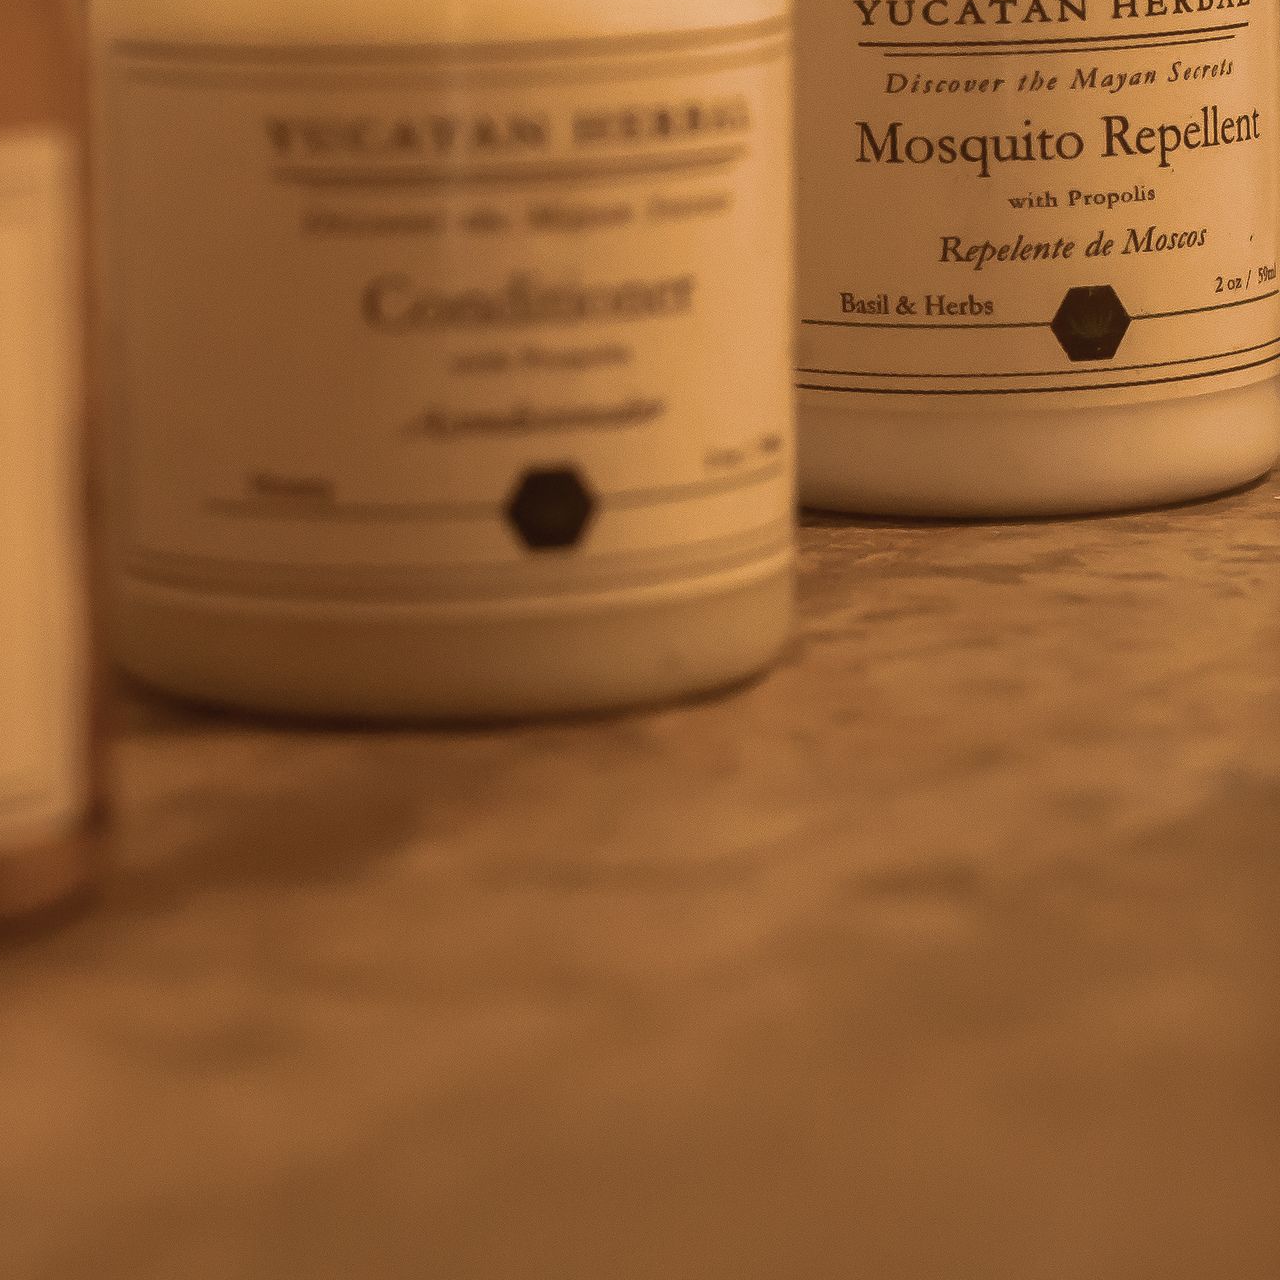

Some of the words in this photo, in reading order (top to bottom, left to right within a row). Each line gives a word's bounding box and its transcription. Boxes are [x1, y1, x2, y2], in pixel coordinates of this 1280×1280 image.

[883, 71, 1006, 96] Discover
[1017, 70, 1058, 93] the
[1069, 66, 1157, 95] Mayan
[1167, 57, 1235, 83] Secrets
[854, 119, 1085, 178] Mosquito
[1099, 105, 1262, 169] Repellent
[1007, 190, 1059, 210] with
[1068, 184, 1157, 210] Propolis
[938, 228, 1076, 272] Repelente
[1084, 229, 1115, 258] de
[1121, 223, 1208, 256] Moscos
[1214, 276, 1224, 294] 2
[1227, 277, 1243, 291] oz
[839, 292, 890, 317] Basil
[895, 294, 917, 316] &
[924, 292, 995, 318] Herbs
